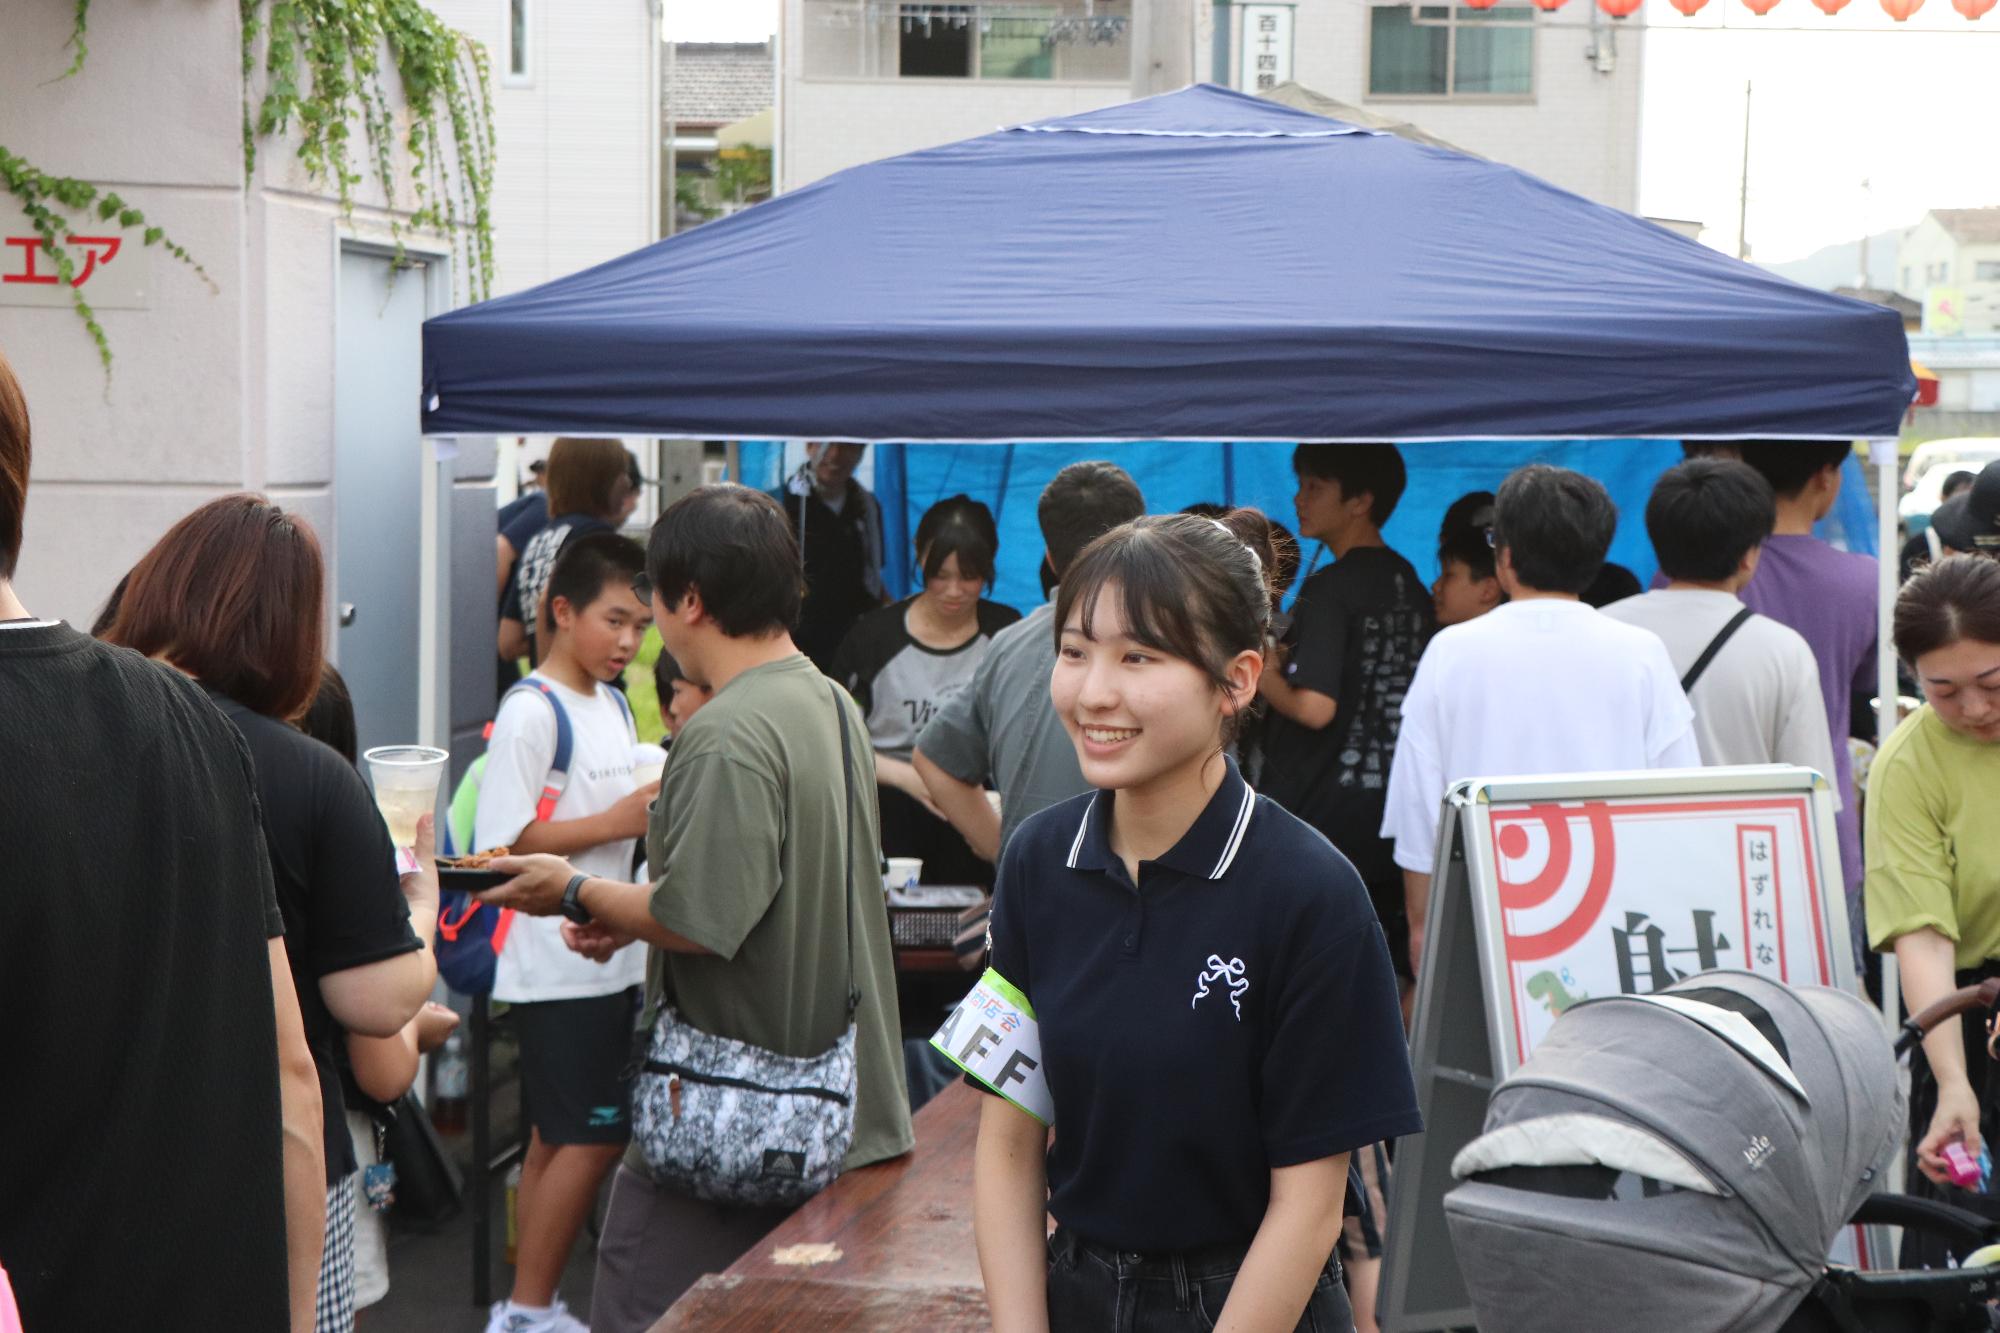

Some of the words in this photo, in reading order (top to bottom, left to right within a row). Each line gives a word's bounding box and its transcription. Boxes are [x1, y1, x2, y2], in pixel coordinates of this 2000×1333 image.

[3, 236, 122, 288] エア
[1749, 839, 1775, 965] はずれな
